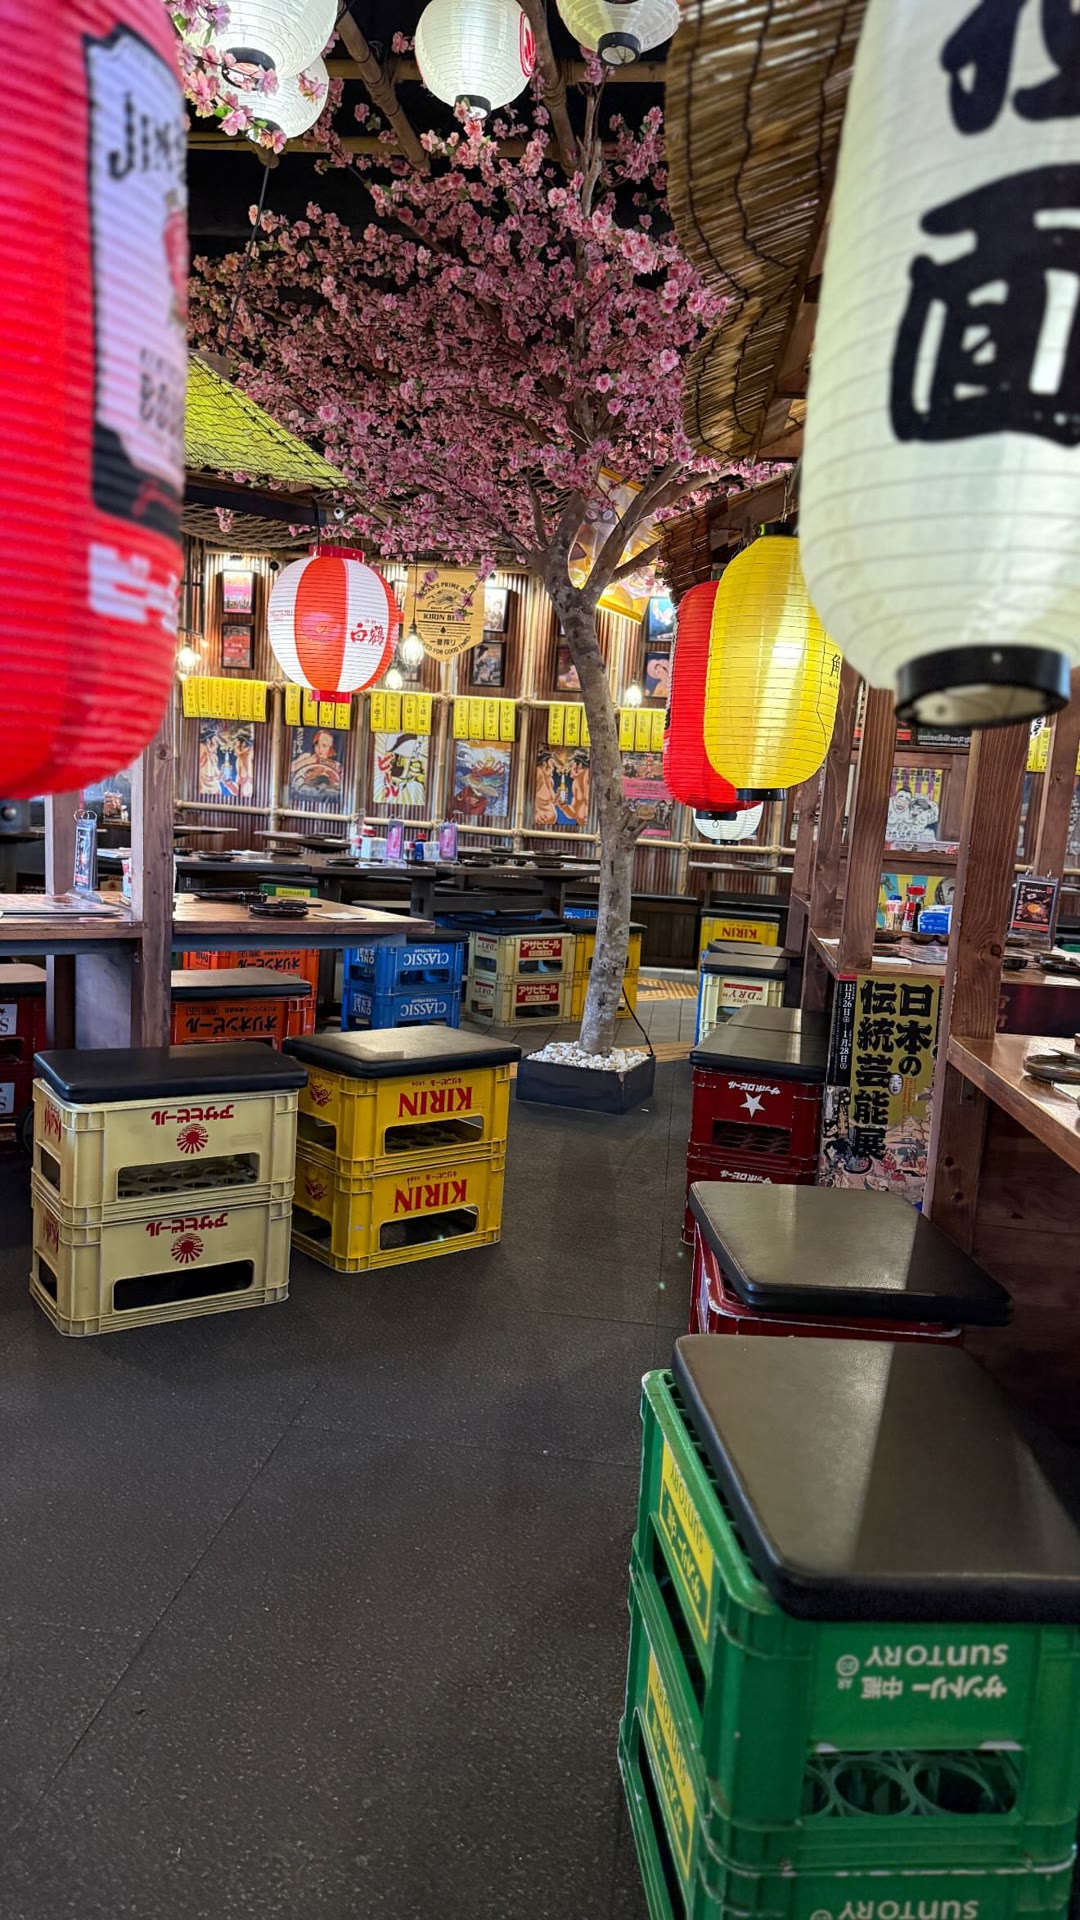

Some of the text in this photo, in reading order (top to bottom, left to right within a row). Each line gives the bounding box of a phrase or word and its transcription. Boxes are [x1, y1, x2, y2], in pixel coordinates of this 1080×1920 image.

[423, 612, 446, 621] KIRIN
[721, 927, 757, 940] KIRIN
[521, 939, 561, 950] アサヒビール
[402, 952, 450, 966] CLASSIC
[517, 983, 558, 996] アサヒビール
[399, 1001, 447, 1017] CLASSIC
[186, 1015, 277, 1035] オリオンビール
[895, 982, 935, 1077] 日本の
[727, 1080, 781, 1096] サッポロビール
[397, 1086, 473, 1118] KIRIN
[151, 1104, 235, 1126] アサヒビール
[393, 1178, 468, 1214] KIRIN
[145, 1213, 229, 1237] アサヒビール
[910, 1674, 1008, 1699] サントリー
